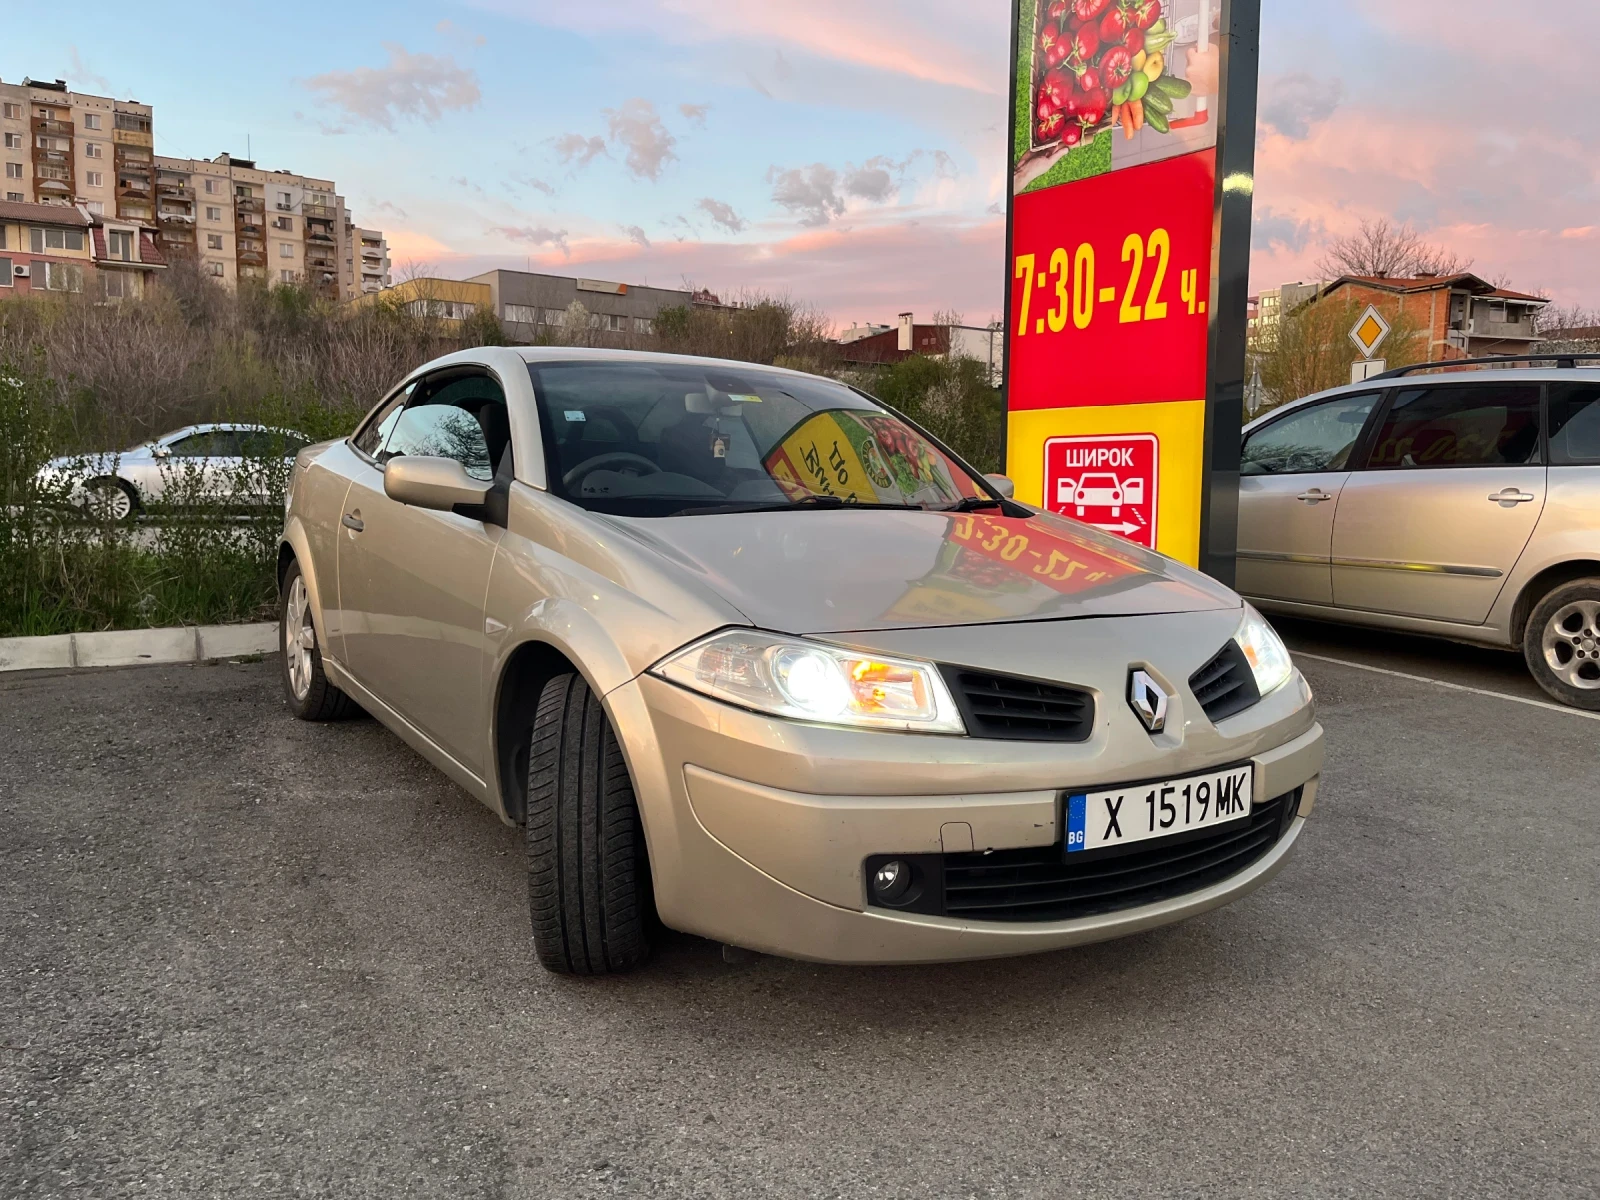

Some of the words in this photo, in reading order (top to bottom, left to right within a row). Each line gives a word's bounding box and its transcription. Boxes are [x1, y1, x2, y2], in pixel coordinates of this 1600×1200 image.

[1015, 229, 1170, 336] 7:30-22
[1180, 268, 1206, 315] ч.
[1066, 447, 1134, 468] ШИРОК
[1103, 795, 1124, 840] X
[1068, 830, 1083, 845] BG
